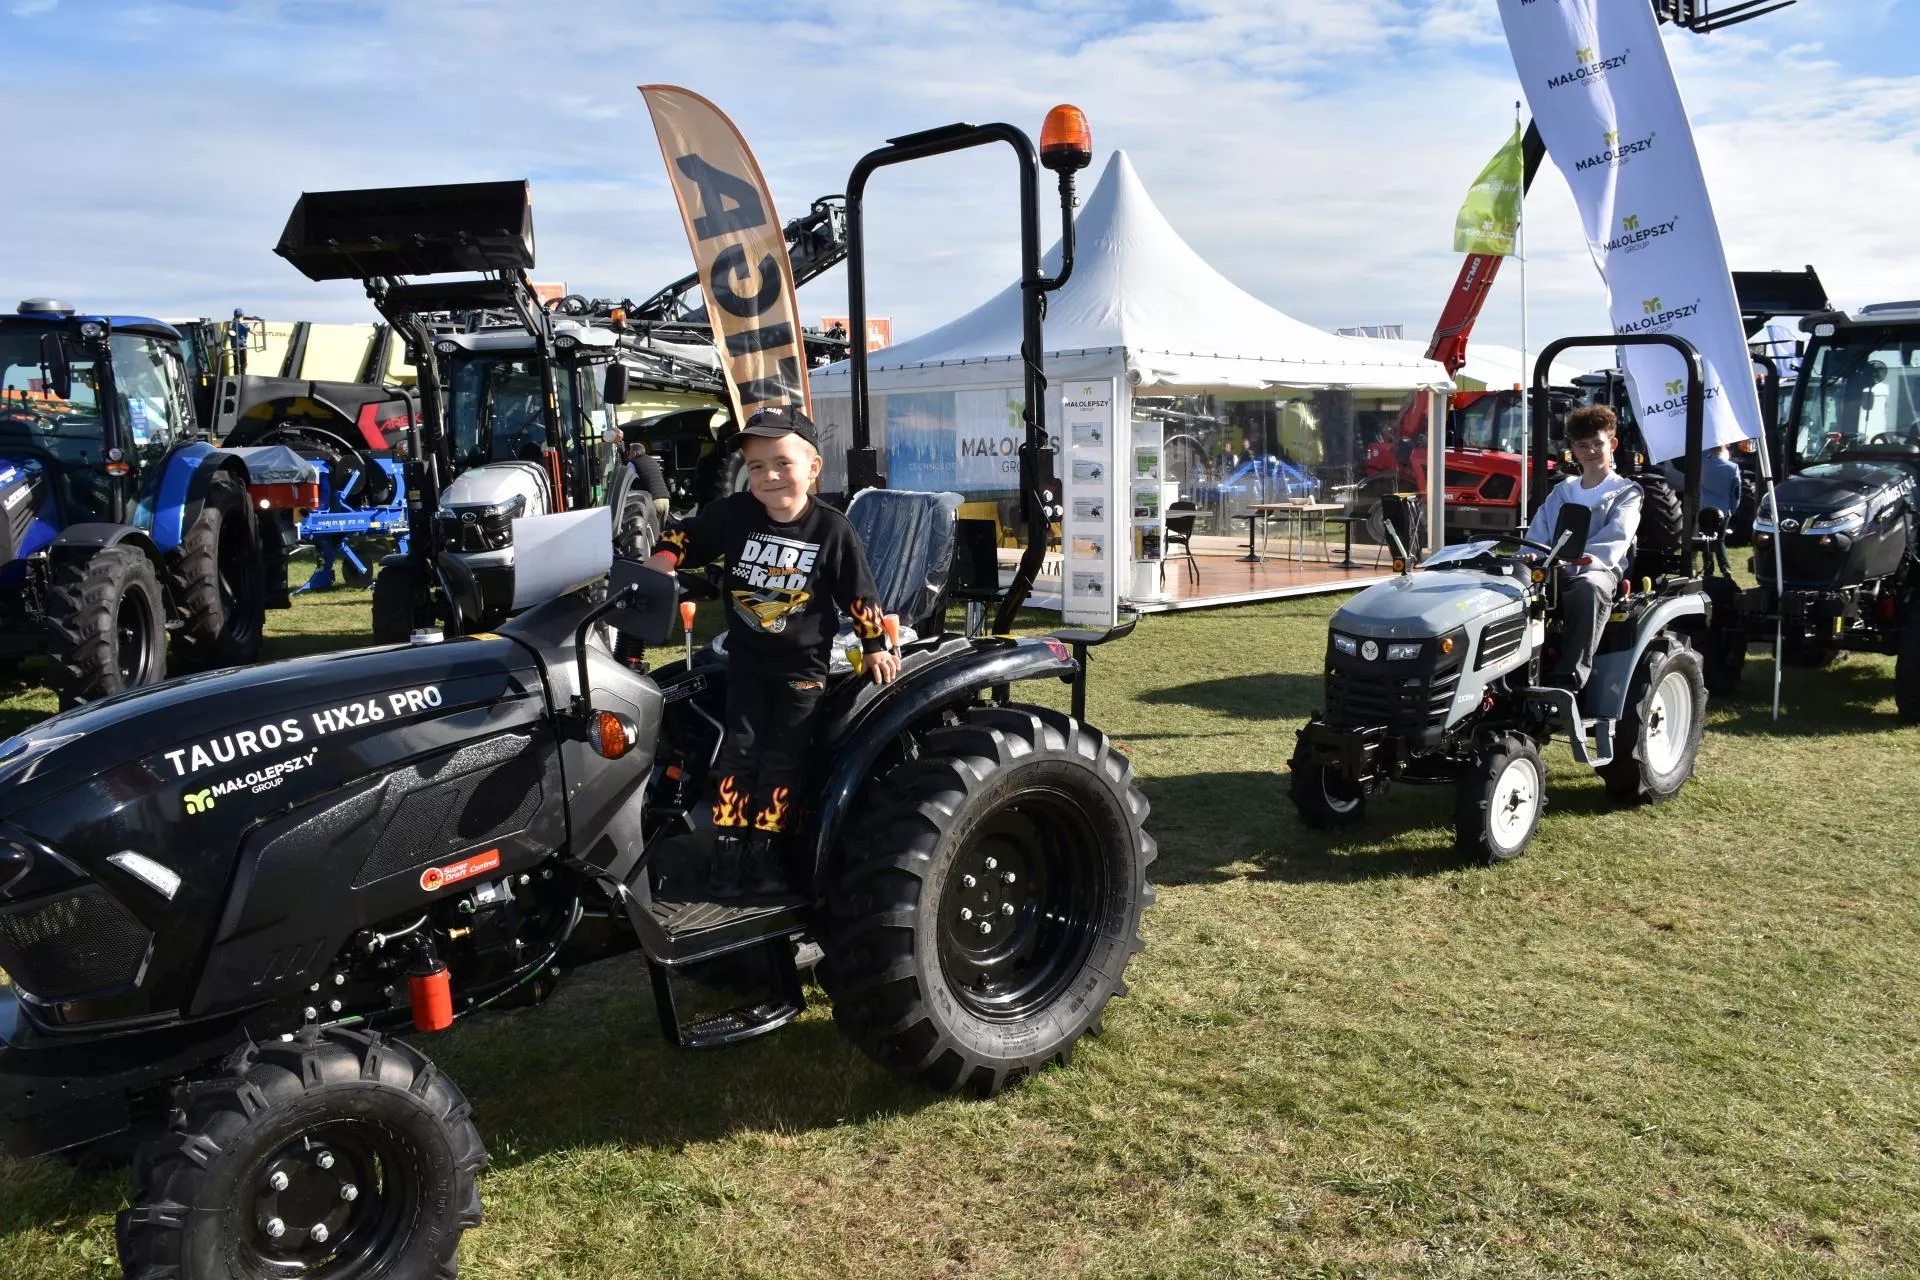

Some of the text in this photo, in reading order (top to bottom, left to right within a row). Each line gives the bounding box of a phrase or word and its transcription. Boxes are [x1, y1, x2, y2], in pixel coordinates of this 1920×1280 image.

[1548, 54, 1627, 89] MAŁOLEPSZY
[1575, 138, 1652, 172] MAŁOLEPSZY
[1603, 221, 1675, 253] MAŁOLEPSZY
[1624, 241, 1650, 253] GROUP
[1643, 387, 1720, 416] AŁOLEZY
[740, 540, 817, 573] DARE
[748, 564, 807, 591] RAD
[164, 685, 443, 776] TAUROS HX26 PRO
[211, 752, 315, 798] MAŁOLEPSZY
[251, 776, 284, 795] GROUP
[443, 862, 469, 875] Super
[445, 858, 498, 882] Draft Control
